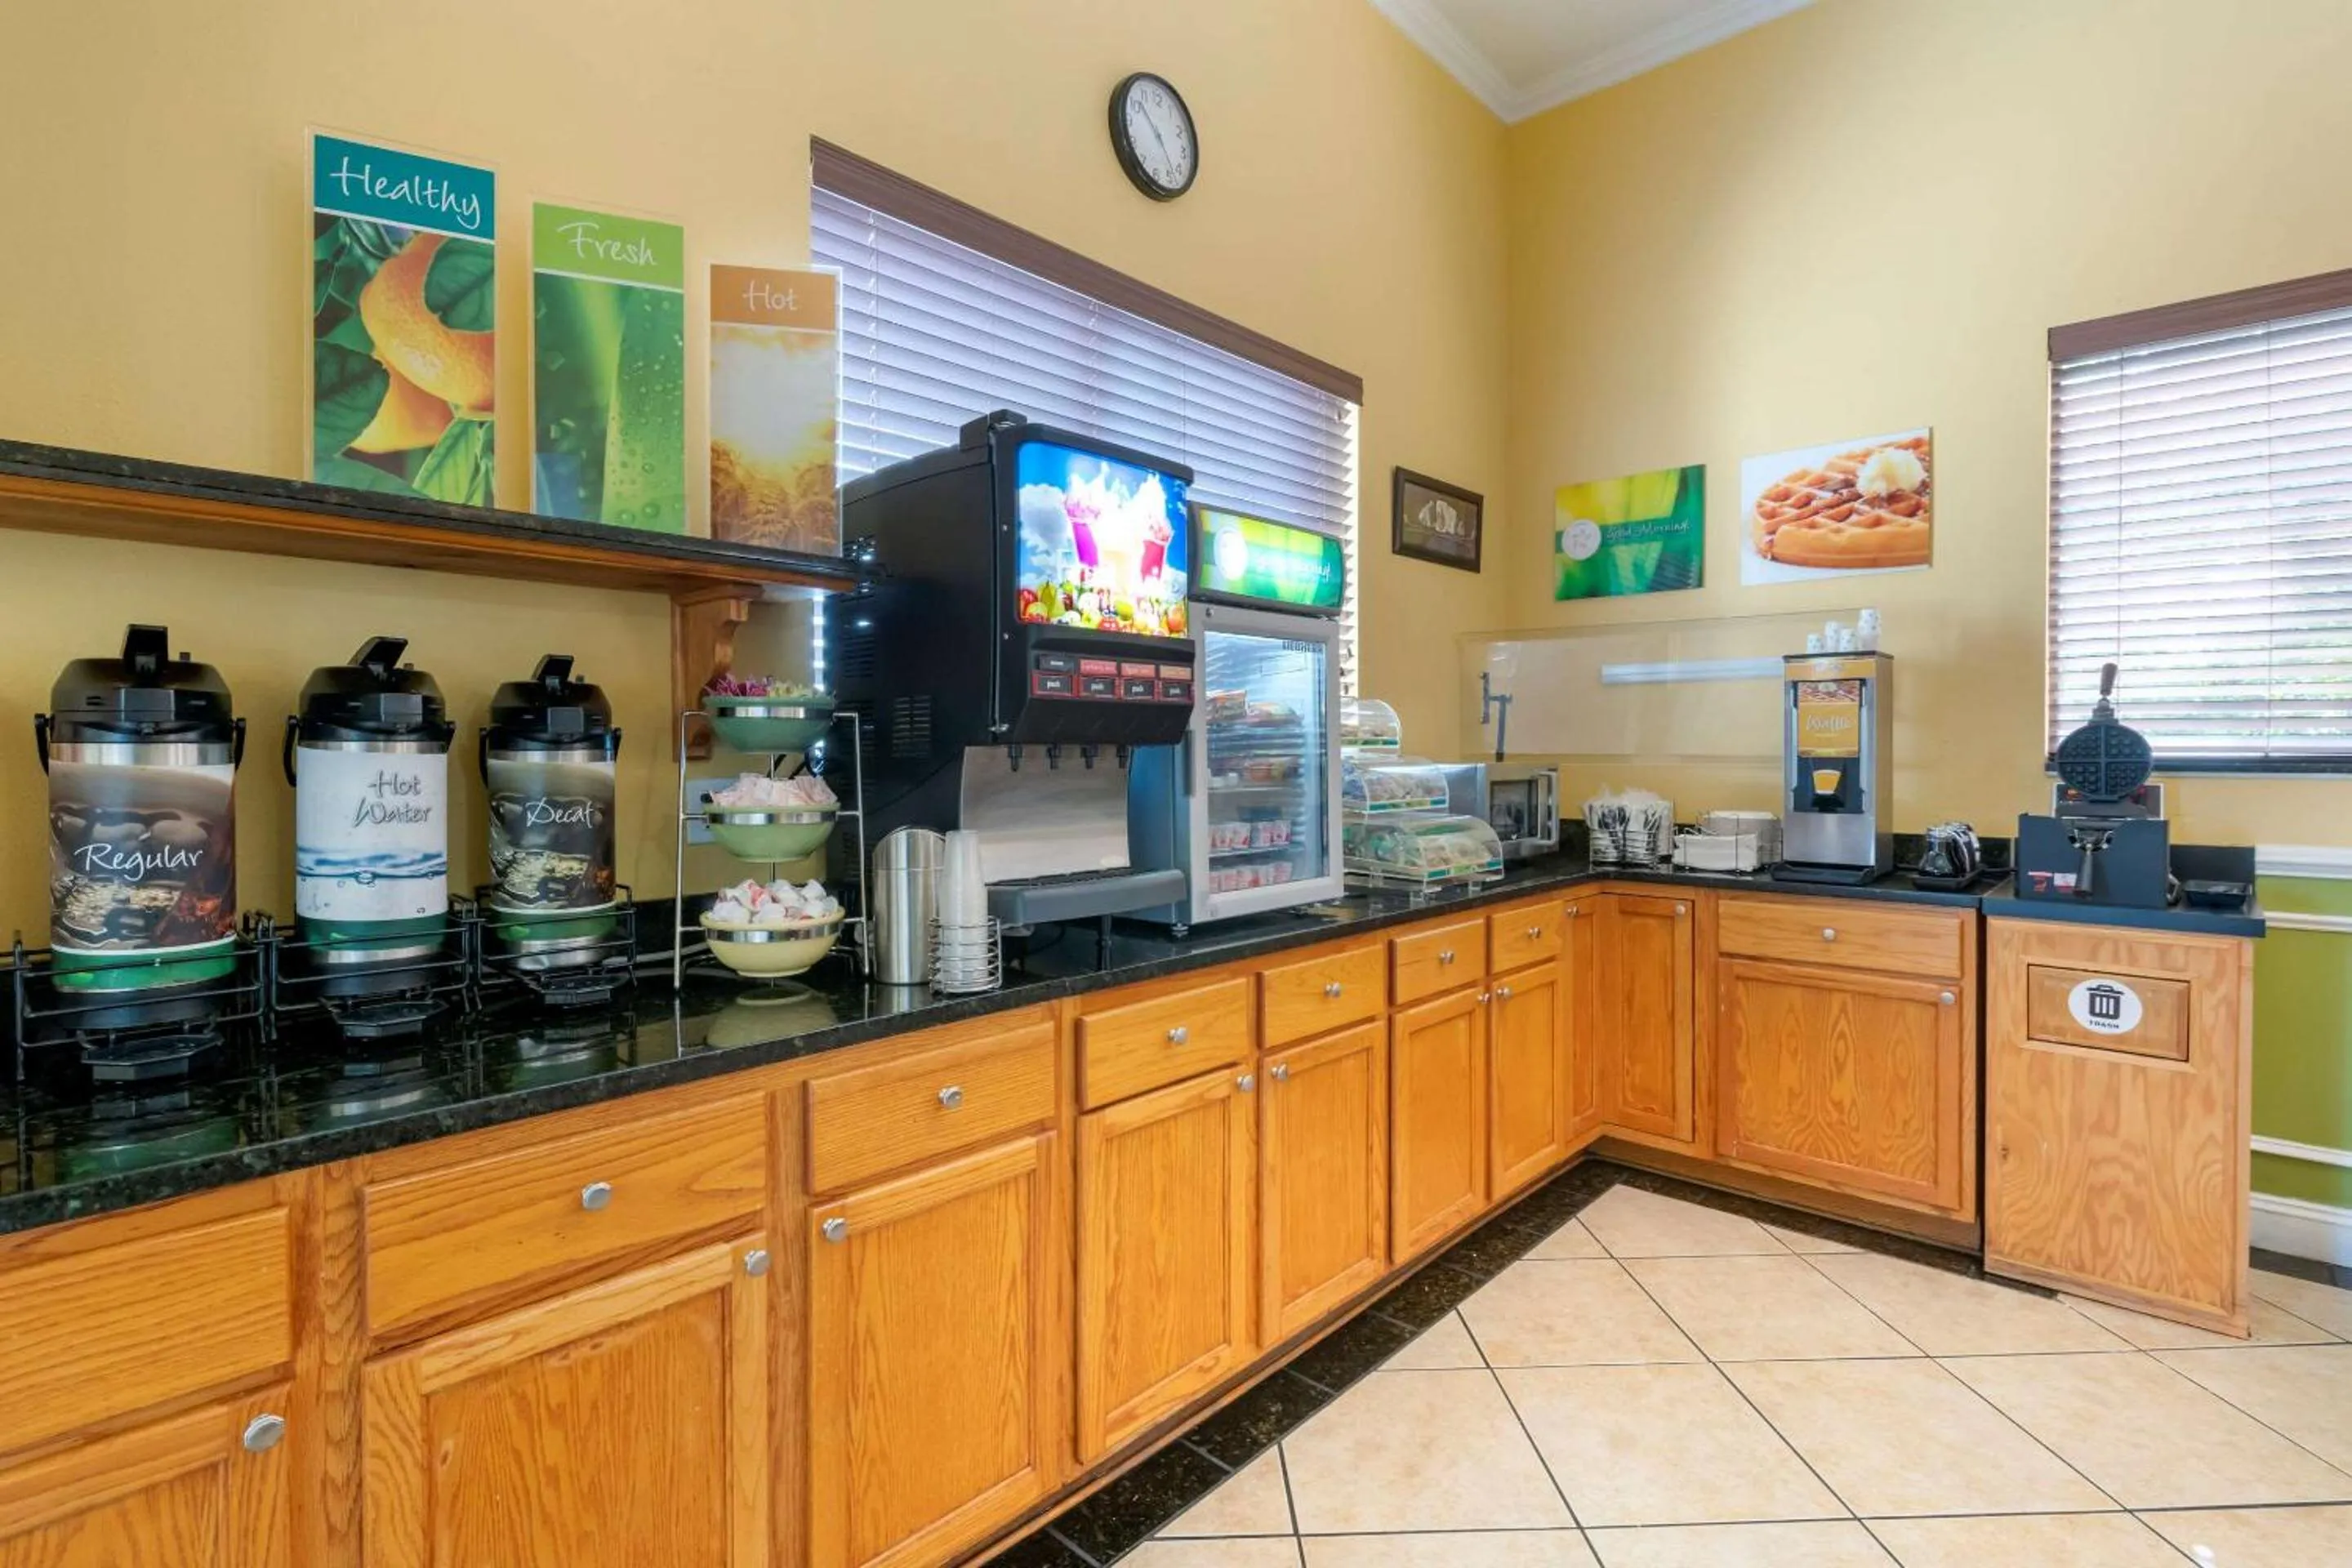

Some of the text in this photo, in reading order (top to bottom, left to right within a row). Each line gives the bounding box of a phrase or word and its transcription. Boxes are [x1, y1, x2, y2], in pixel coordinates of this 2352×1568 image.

[330, 156, 480, 230] Healthy
[557, 221, 658, 266] Fresh
[742, 279, 799, 312] Hot
[368, 769, 421, 799] Hot
[352, 797, 432, 827] Water
[525, 796, 594, 829] Decaf
[74, 843, 203, 881] Regular
